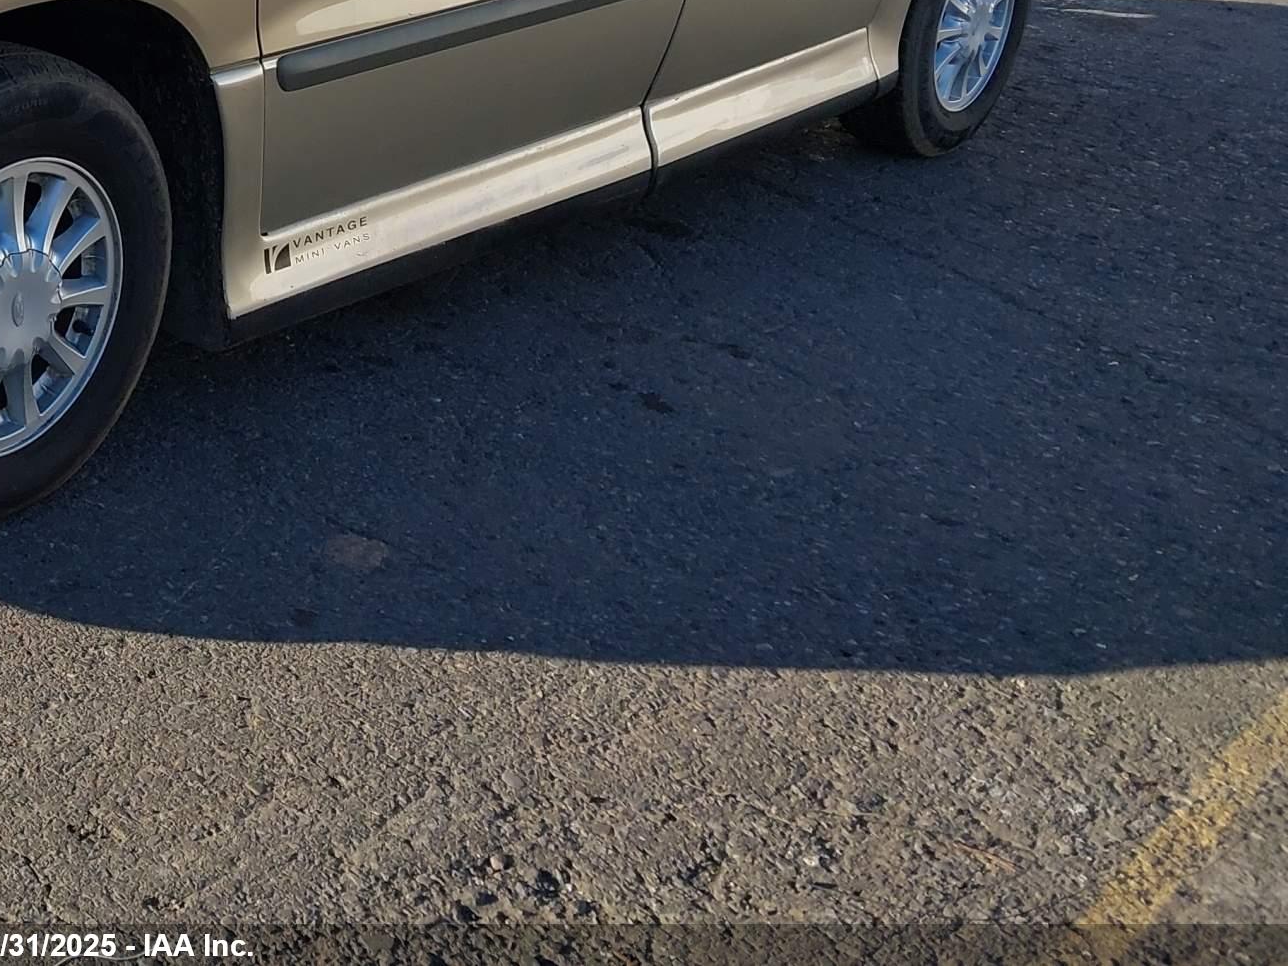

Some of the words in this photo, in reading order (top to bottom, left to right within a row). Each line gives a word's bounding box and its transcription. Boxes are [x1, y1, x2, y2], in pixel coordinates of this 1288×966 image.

[292, 216, 368, 249] VANTAGE
[294, 248, 326, 265] MINI
[334, 232, 371, 251] VANS
